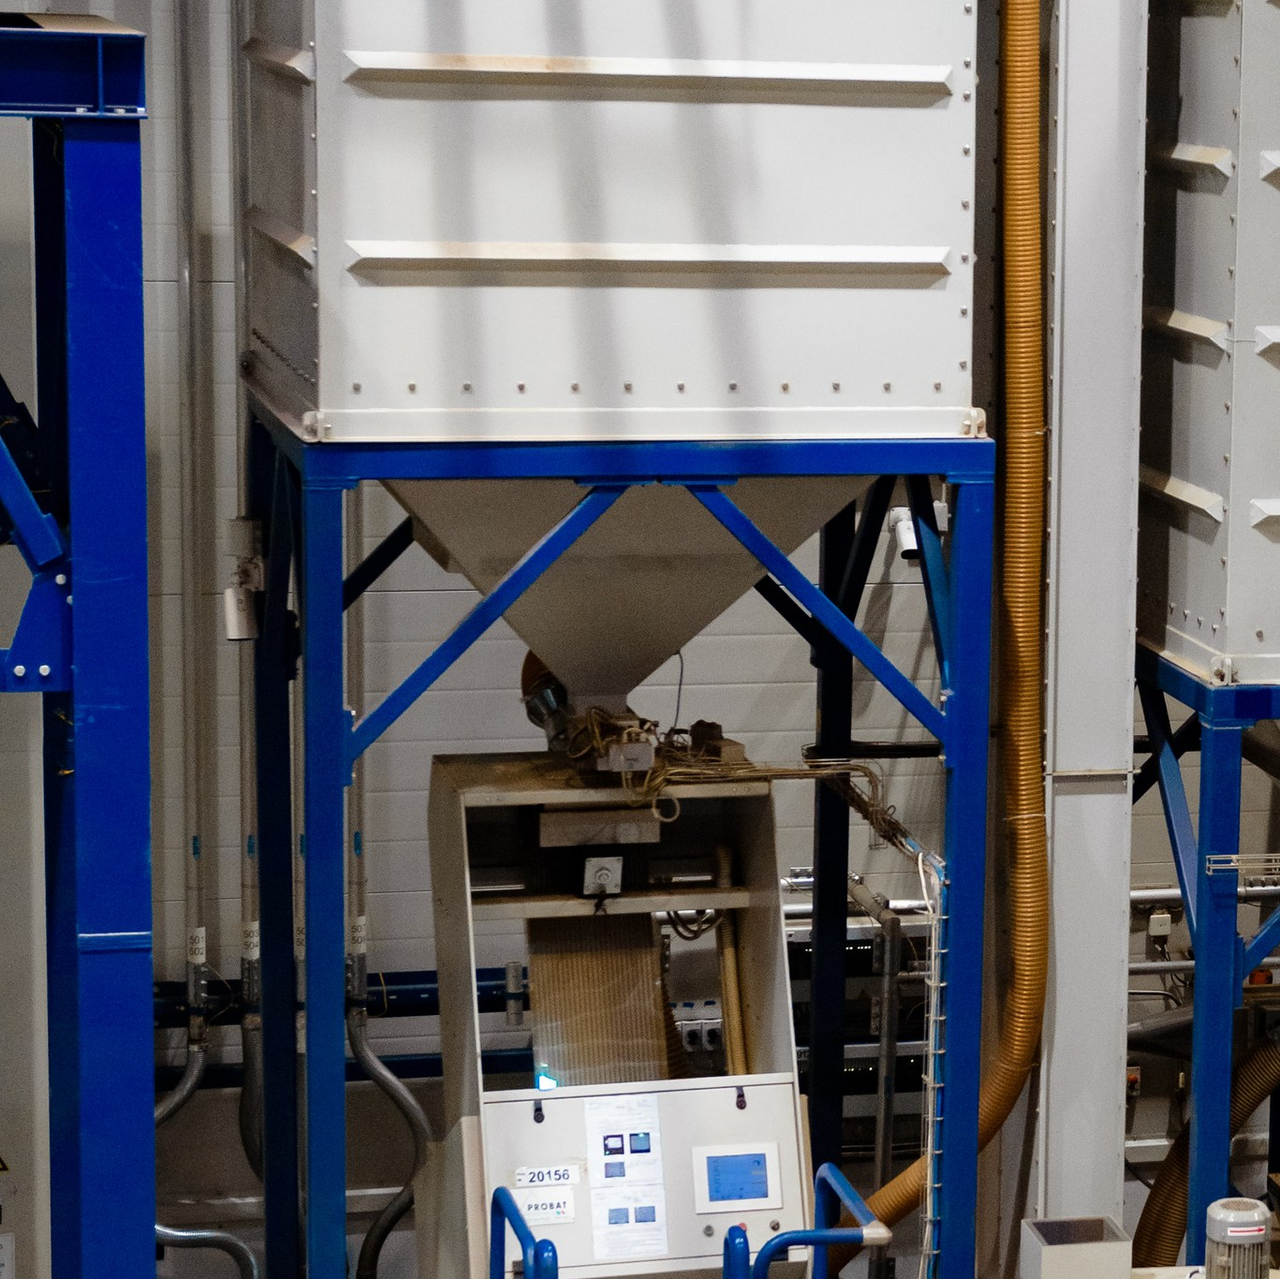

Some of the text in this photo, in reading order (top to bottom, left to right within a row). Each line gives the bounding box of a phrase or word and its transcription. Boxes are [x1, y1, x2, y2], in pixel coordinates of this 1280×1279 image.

[243, 930, 259, 939] 503
[189, 935, 204, 945] 501
[189, 947, 204, 956] 502
[528, 1168, 570, 1183] 20156
[527, 1201, 567, 1212] PROBAT
